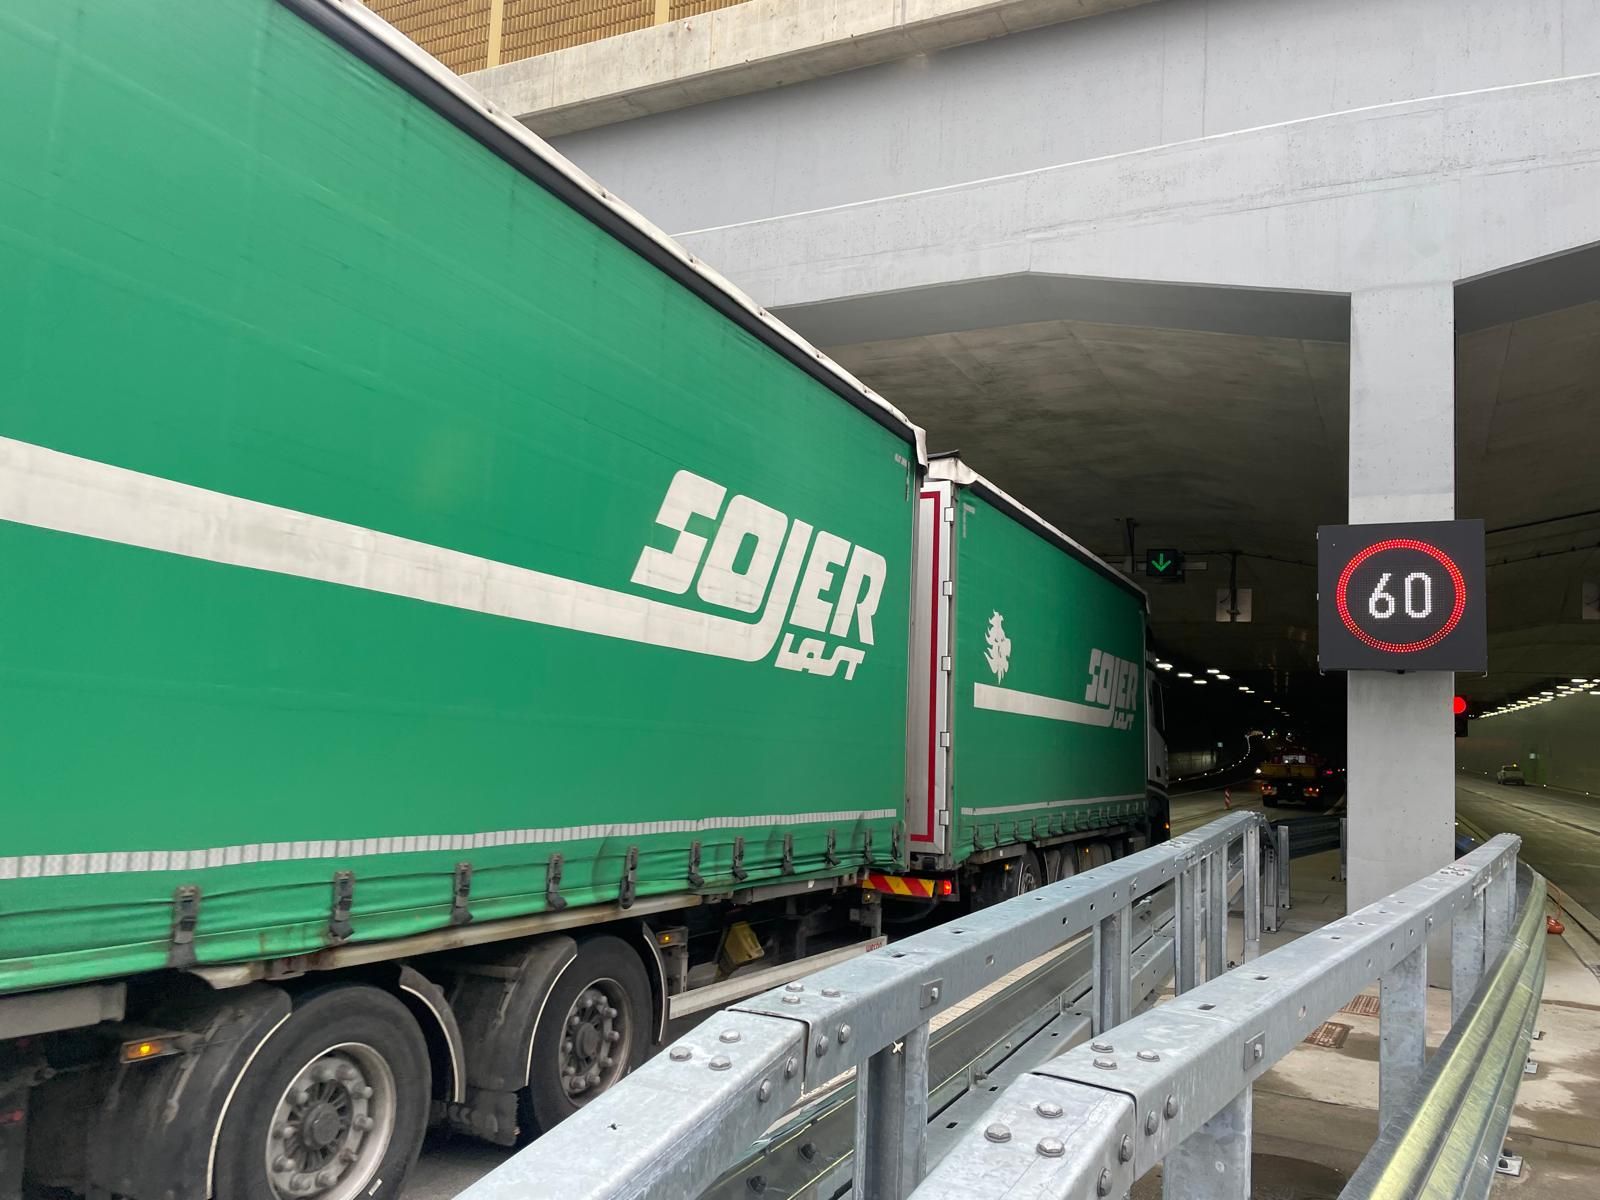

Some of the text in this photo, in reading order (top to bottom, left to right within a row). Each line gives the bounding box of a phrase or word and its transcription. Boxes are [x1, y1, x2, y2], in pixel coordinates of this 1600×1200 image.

[630, 469, 887, 662] SOJER
[1368, 572, 1432, 619] 60
[774, 632, 866, 681] LAST
[1085, 648, 1138, 726] SOJER
